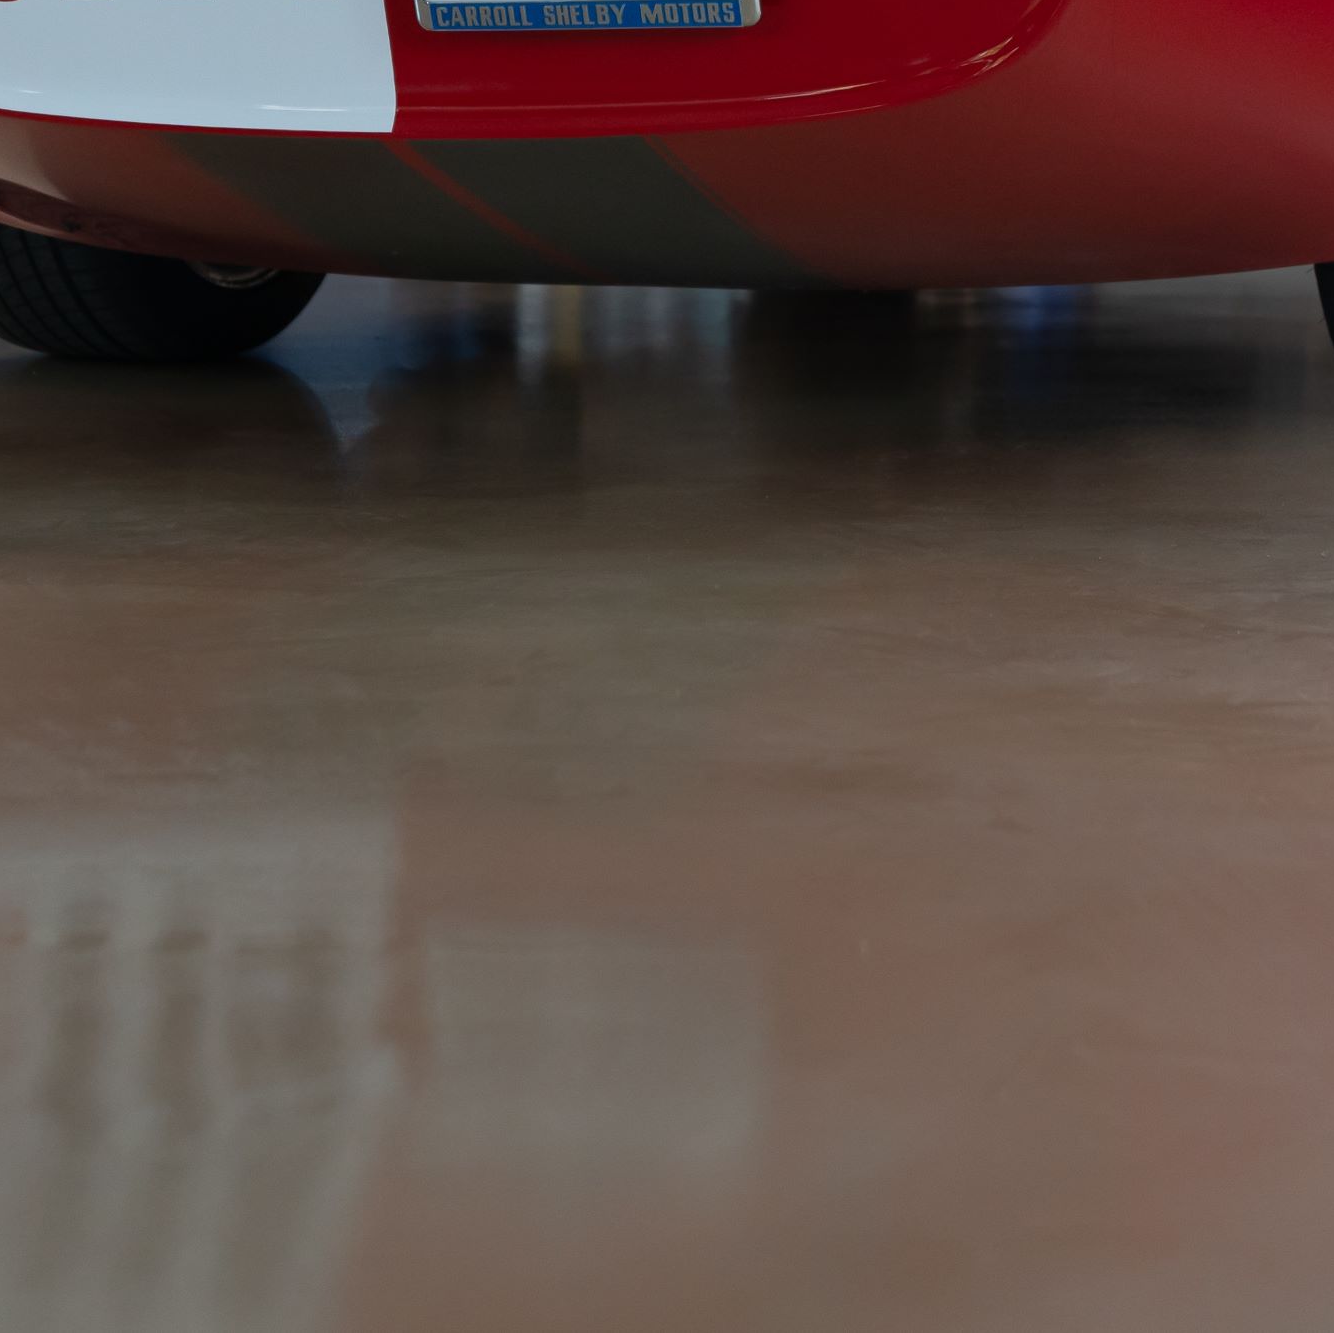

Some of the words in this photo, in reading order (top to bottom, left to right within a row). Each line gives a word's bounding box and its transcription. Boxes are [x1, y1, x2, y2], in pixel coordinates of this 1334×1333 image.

[436, 5, 533, 27] CARROLL
[543, 4, 625, 26] SHELBY
[640, 2, 735, 24] MOTORS
